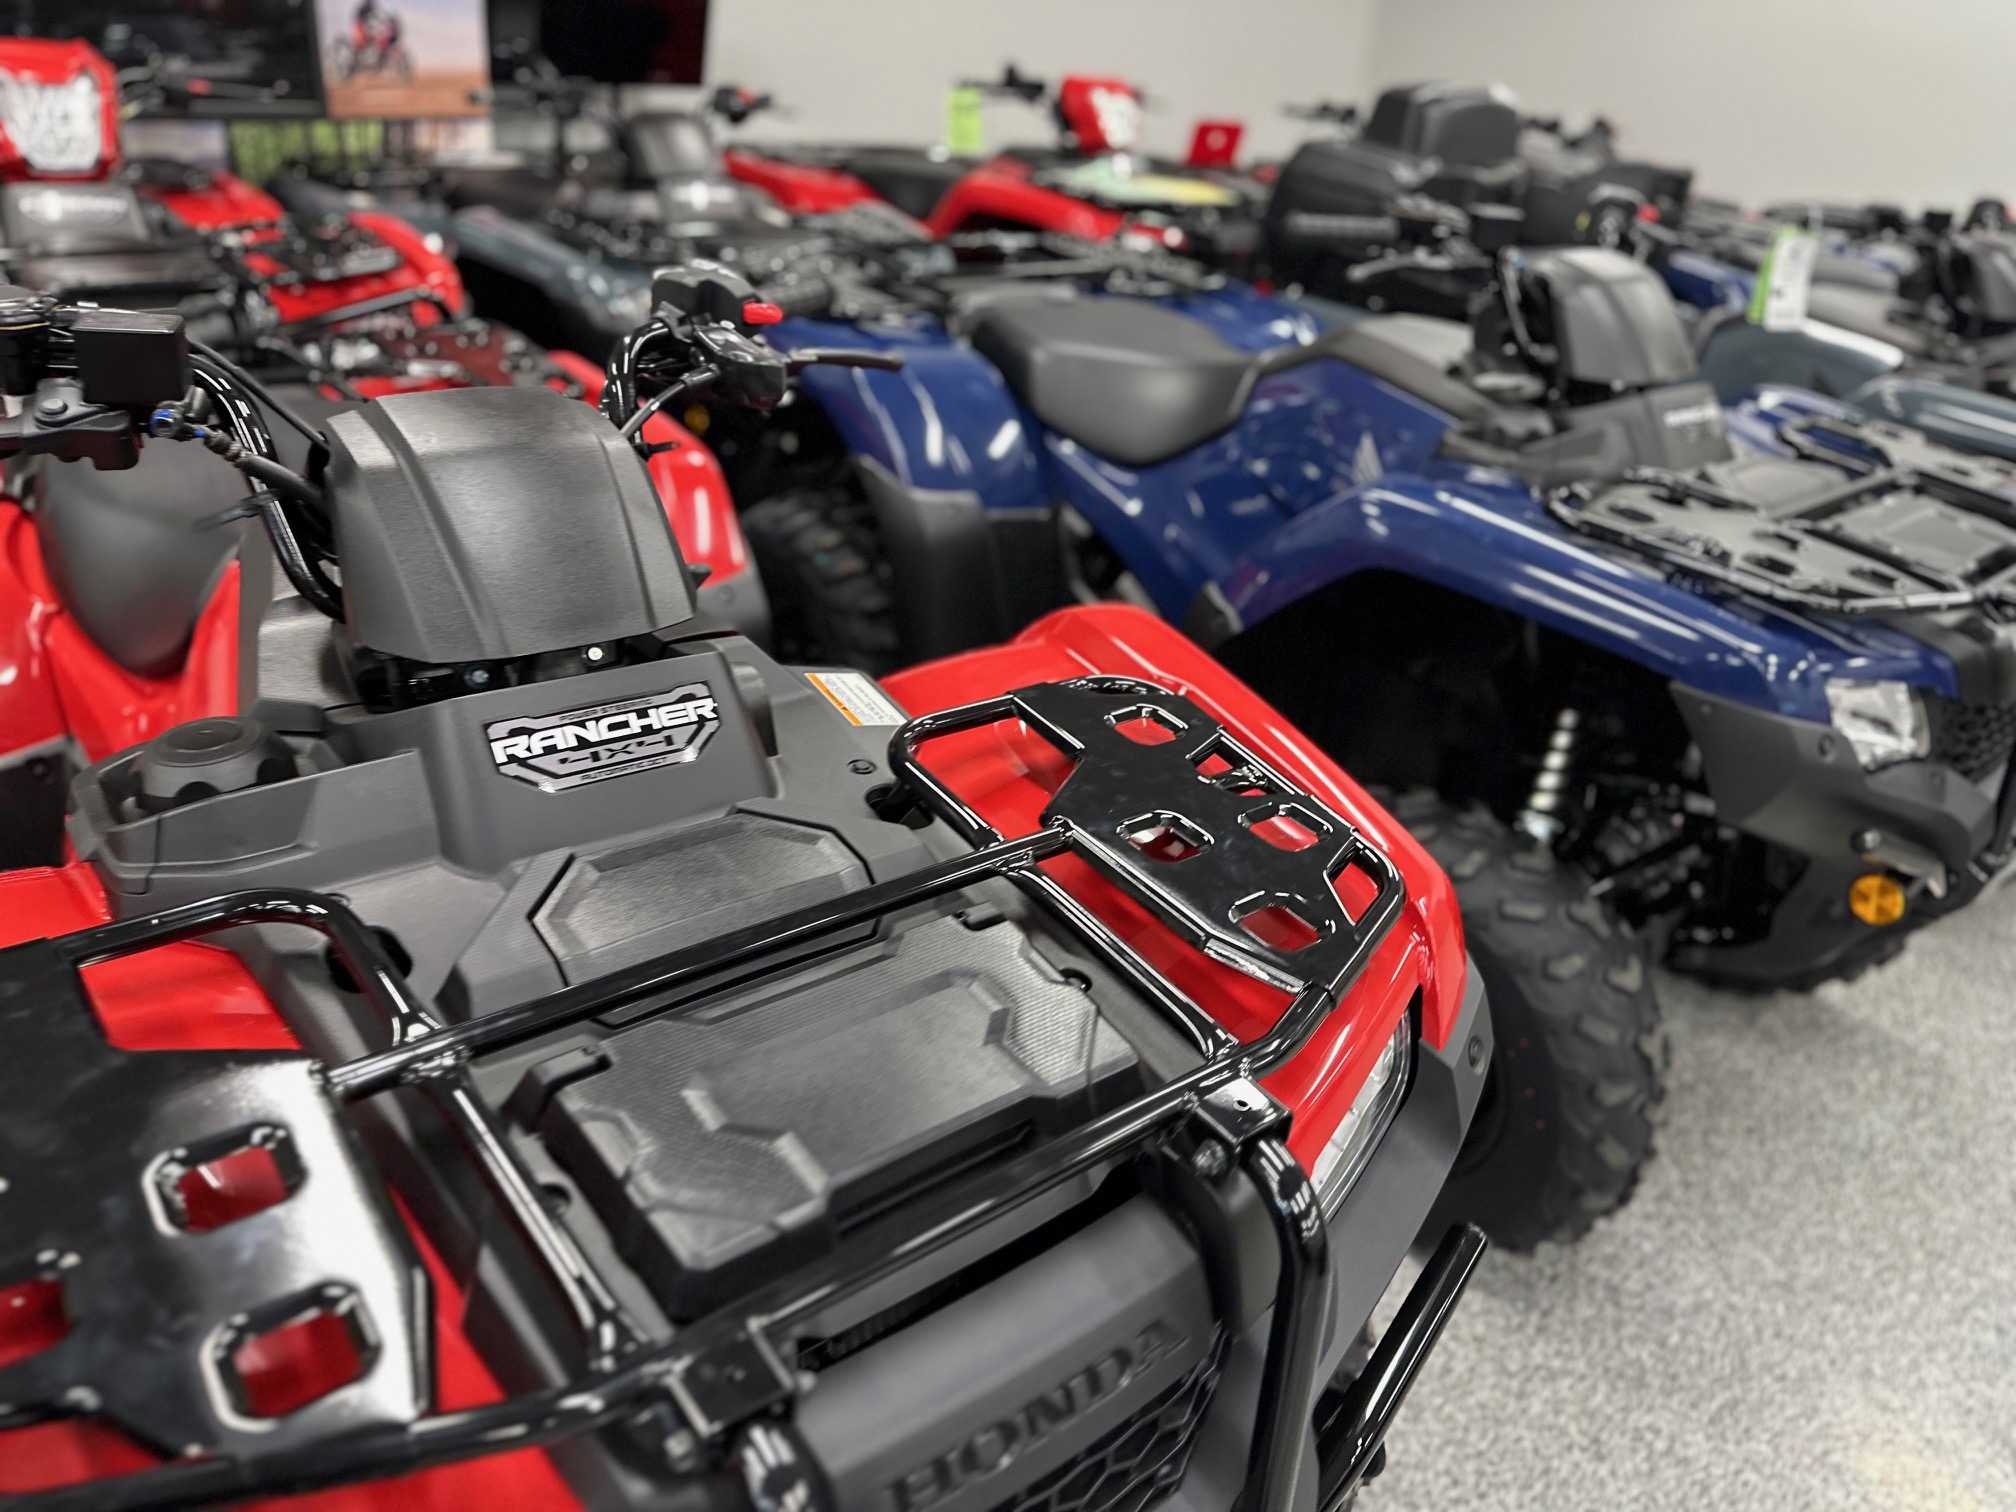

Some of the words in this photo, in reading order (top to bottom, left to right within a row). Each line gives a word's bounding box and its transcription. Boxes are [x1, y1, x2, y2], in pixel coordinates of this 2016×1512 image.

[490, 697, 718, 764] RANCHER
[559, 708, 599, 721] POWER
[581, 762, 645, 780] AUTOMATIC
[884, 1317, 1191, 1512] HONDA
